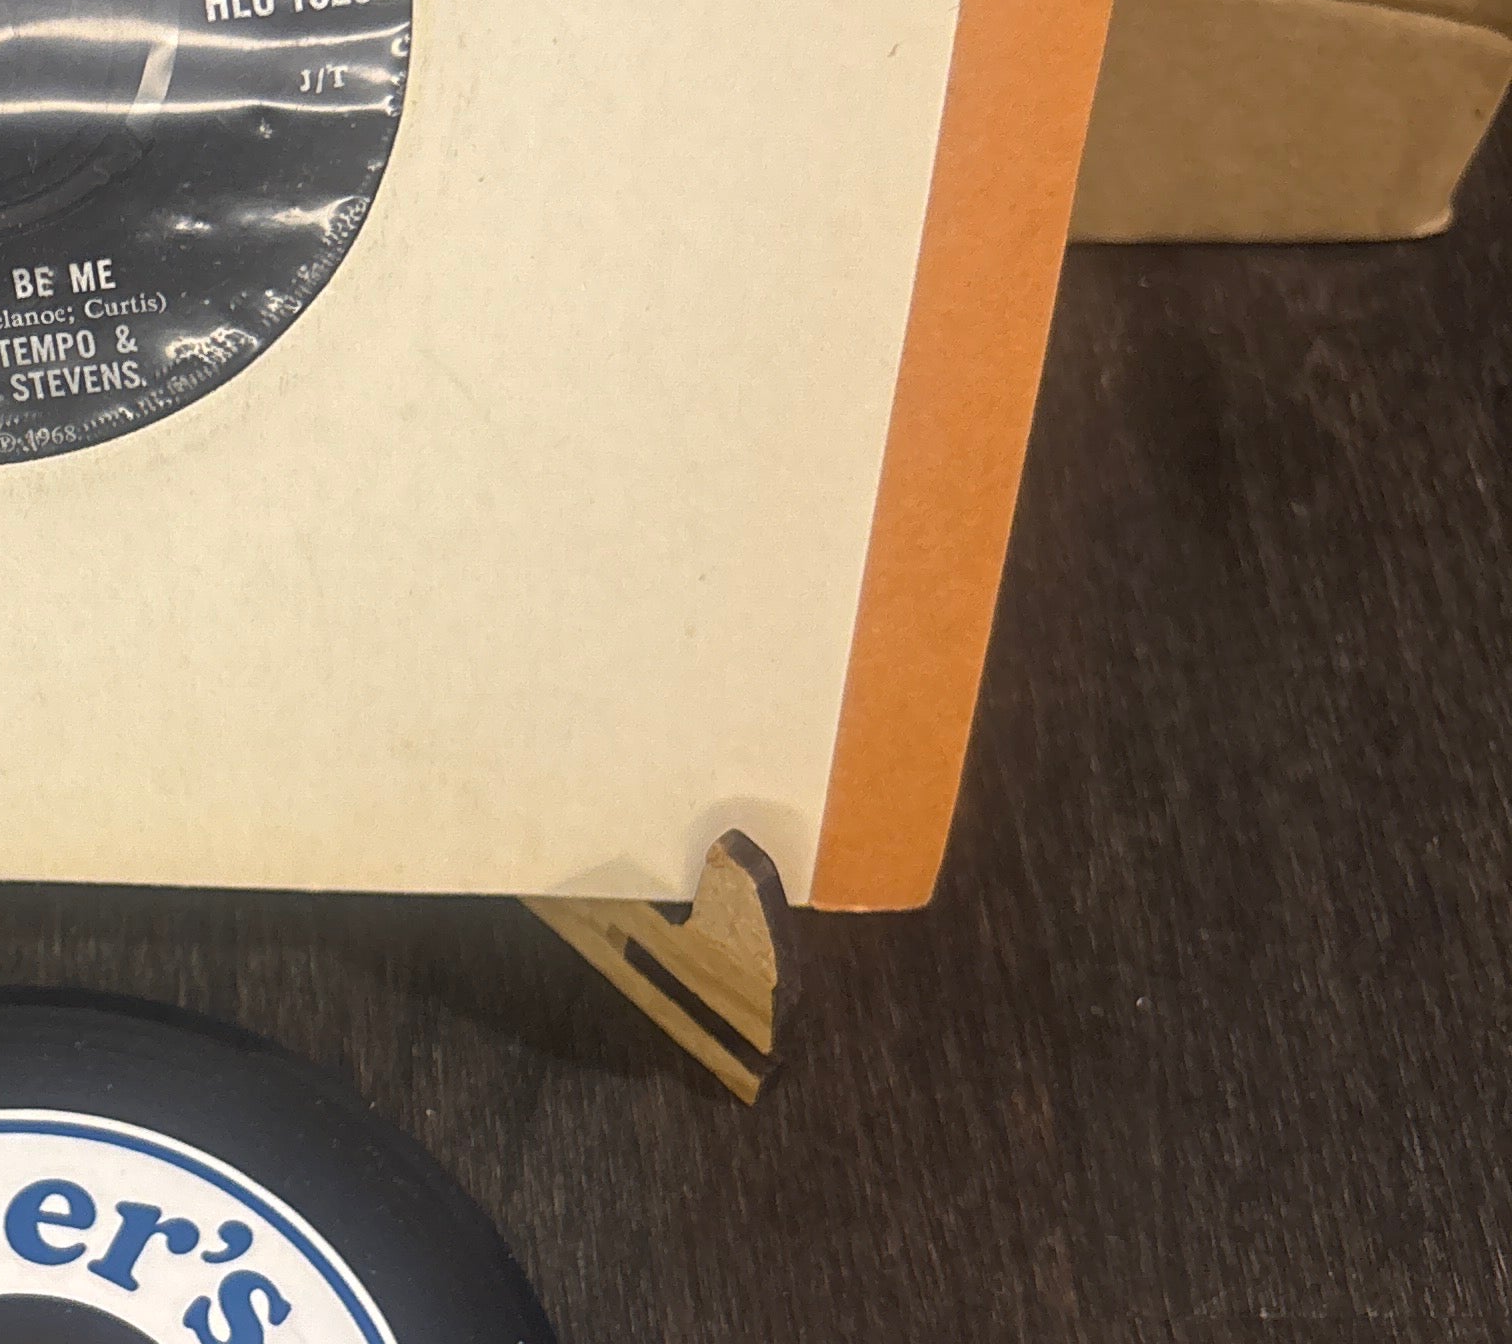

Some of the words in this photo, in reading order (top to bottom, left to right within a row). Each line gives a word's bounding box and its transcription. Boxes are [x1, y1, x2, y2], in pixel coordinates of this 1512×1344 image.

[299, 63, 348, 94] J/T
[12, 266, 54, 299] BE
[69, 258, 117, 294] ME
[84, 292, 166, 320] Curtis)
[115, 324, 139, 355] &
